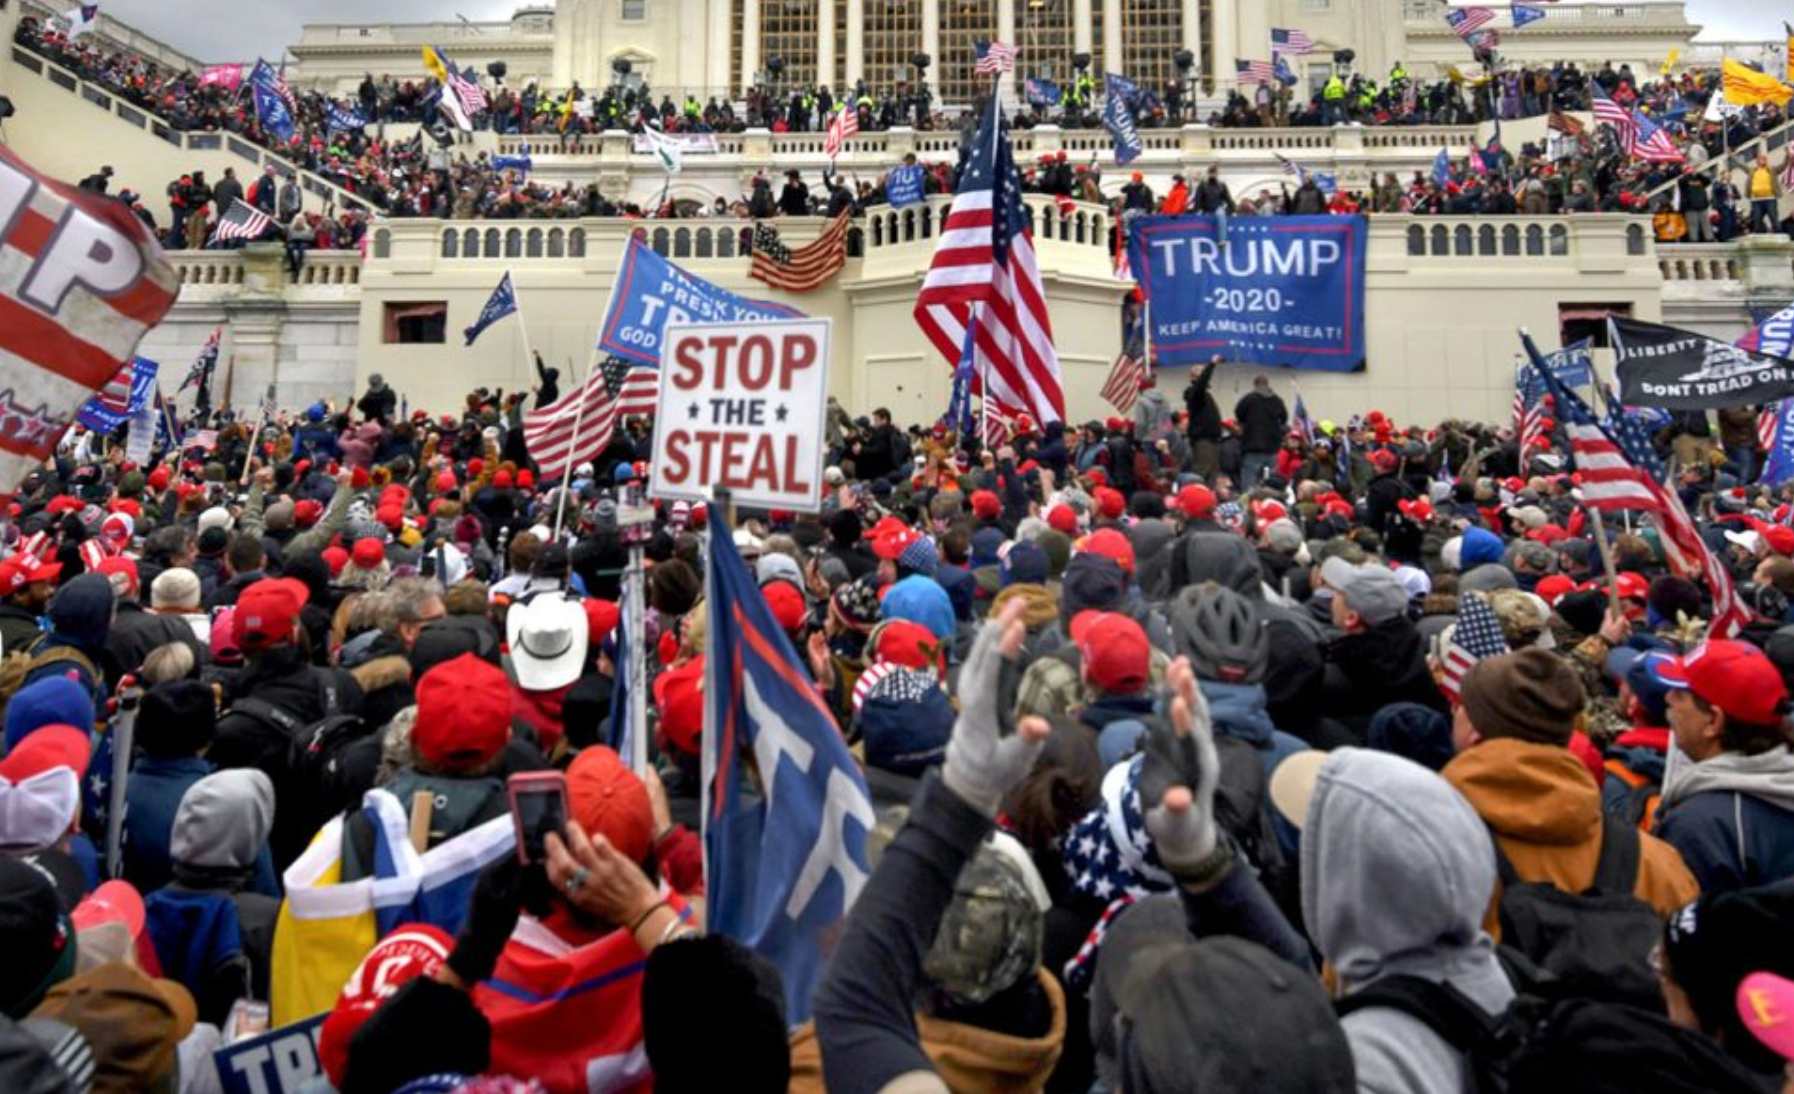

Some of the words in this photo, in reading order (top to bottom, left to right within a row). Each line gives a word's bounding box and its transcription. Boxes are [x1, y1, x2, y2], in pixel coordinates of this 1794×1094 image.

[1151, 238, 1340, 277] TRUMP
[620, 326, 656, 347] GOD
[1158, 319, 1200, 336] KEEP
[1206, 320, 1278, 336] AMERICA
[1283, 323, 1342, 339] GREAT!
[671, 334, 818, 391] STOP
[1627, 338, 1698, 358] LIBERTY
[1641, 382, 1691, 397] DONT
[1695, 374, 1752, 396] TREAD
[1757, 366, 1787, 383] ON
[708, 398, 767, 426] THE
[662, 429, 809, 495] STEAL
